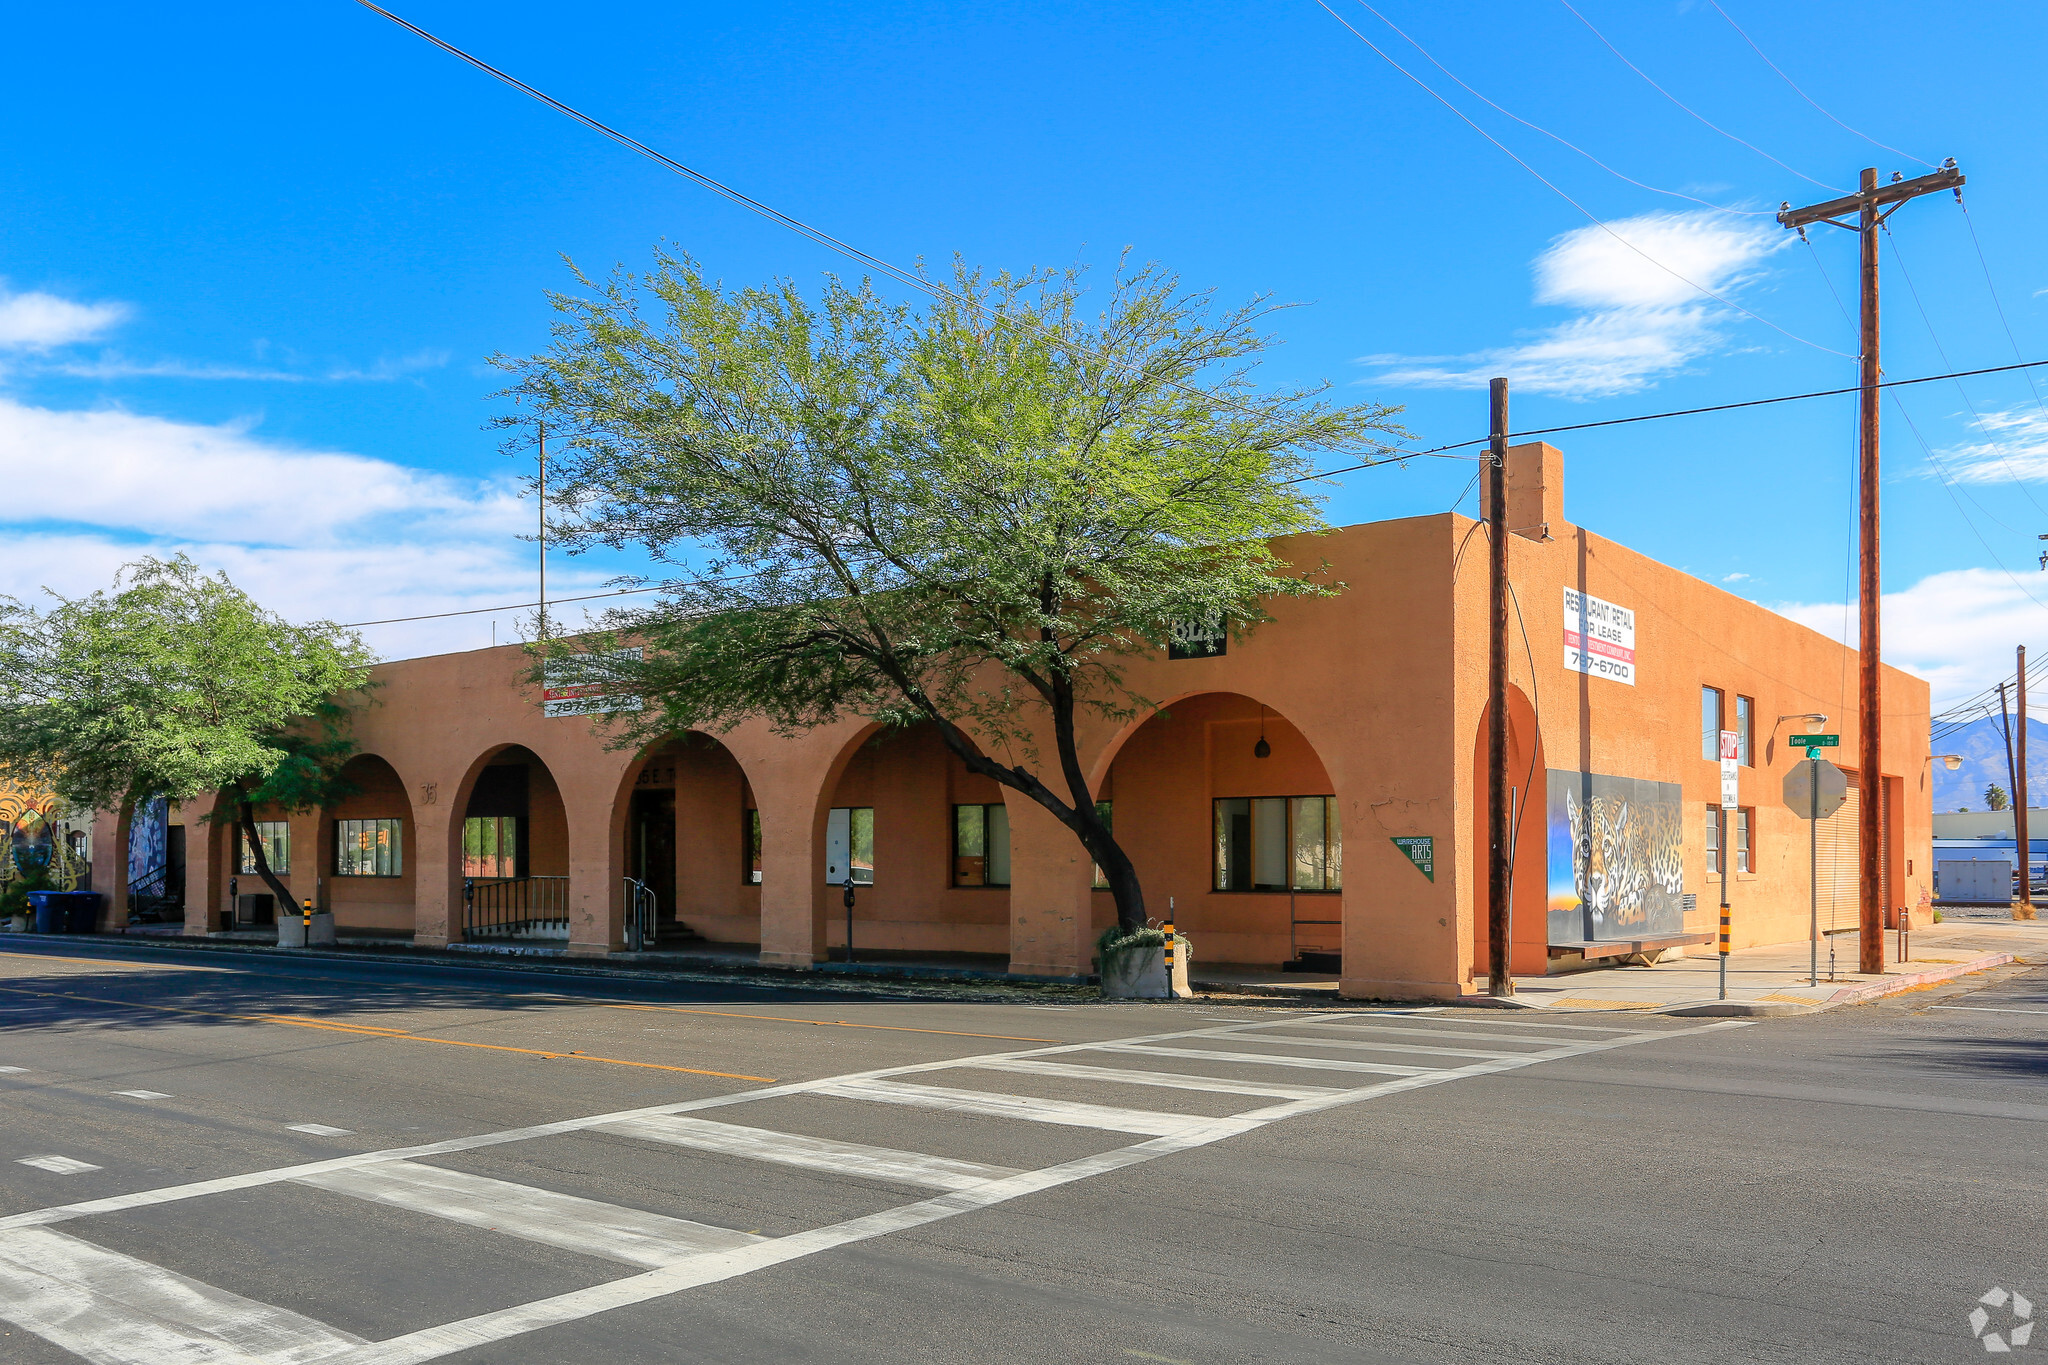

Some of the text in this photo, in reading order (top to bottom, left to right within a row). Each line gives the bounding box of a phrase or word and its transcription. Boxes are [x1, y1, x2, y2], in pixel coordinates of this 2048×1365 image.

[1579, 619, 1622, 643] FOR LEASE
[1571, 651, 1629, 678] 797-6700
[1721, 733, 1737, 758] STOP
[1791, 736, 1806, 745] Toole
[420, 782, 438, 805] 35
[1411, 844, 1432, 859] ARTS
